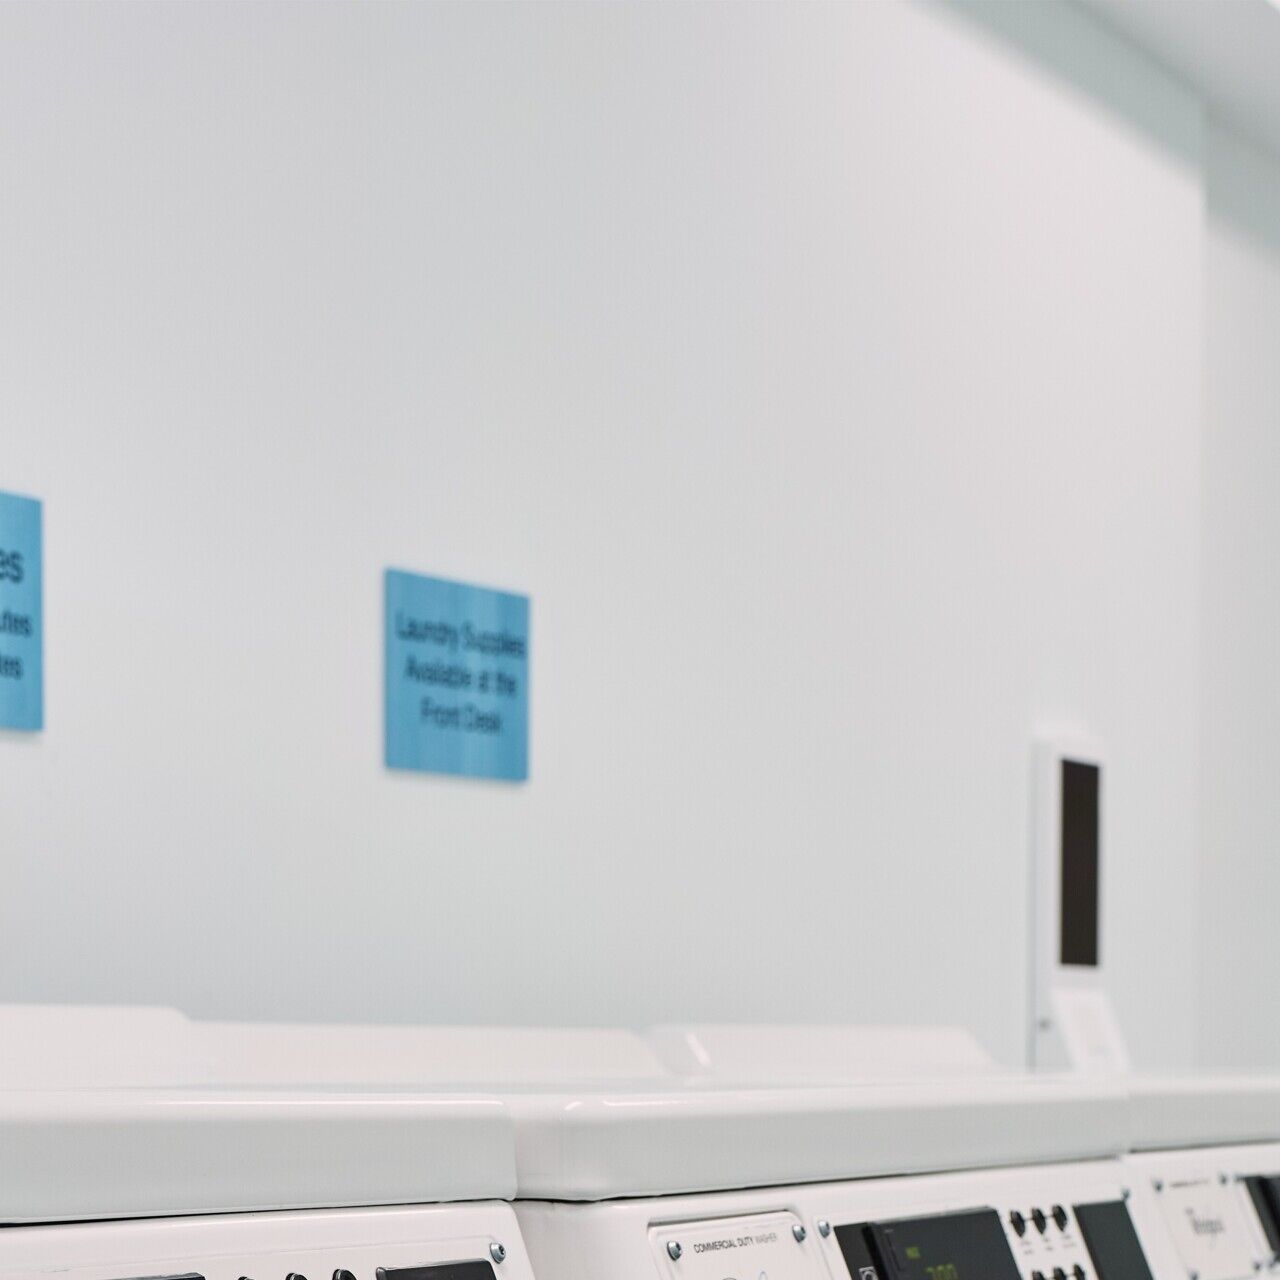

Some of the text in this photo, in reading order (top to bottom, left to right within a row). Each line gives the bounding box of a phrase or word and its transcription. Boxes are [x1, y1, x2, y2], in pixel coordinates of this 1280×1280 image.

[395, 613, 525, 659] Laundry Supplies
[404, 655, 471, 689] Available
[693, 1239, 737, 1254] COMMERCIAL
[737, 1237, 753, 1247] DUTY
